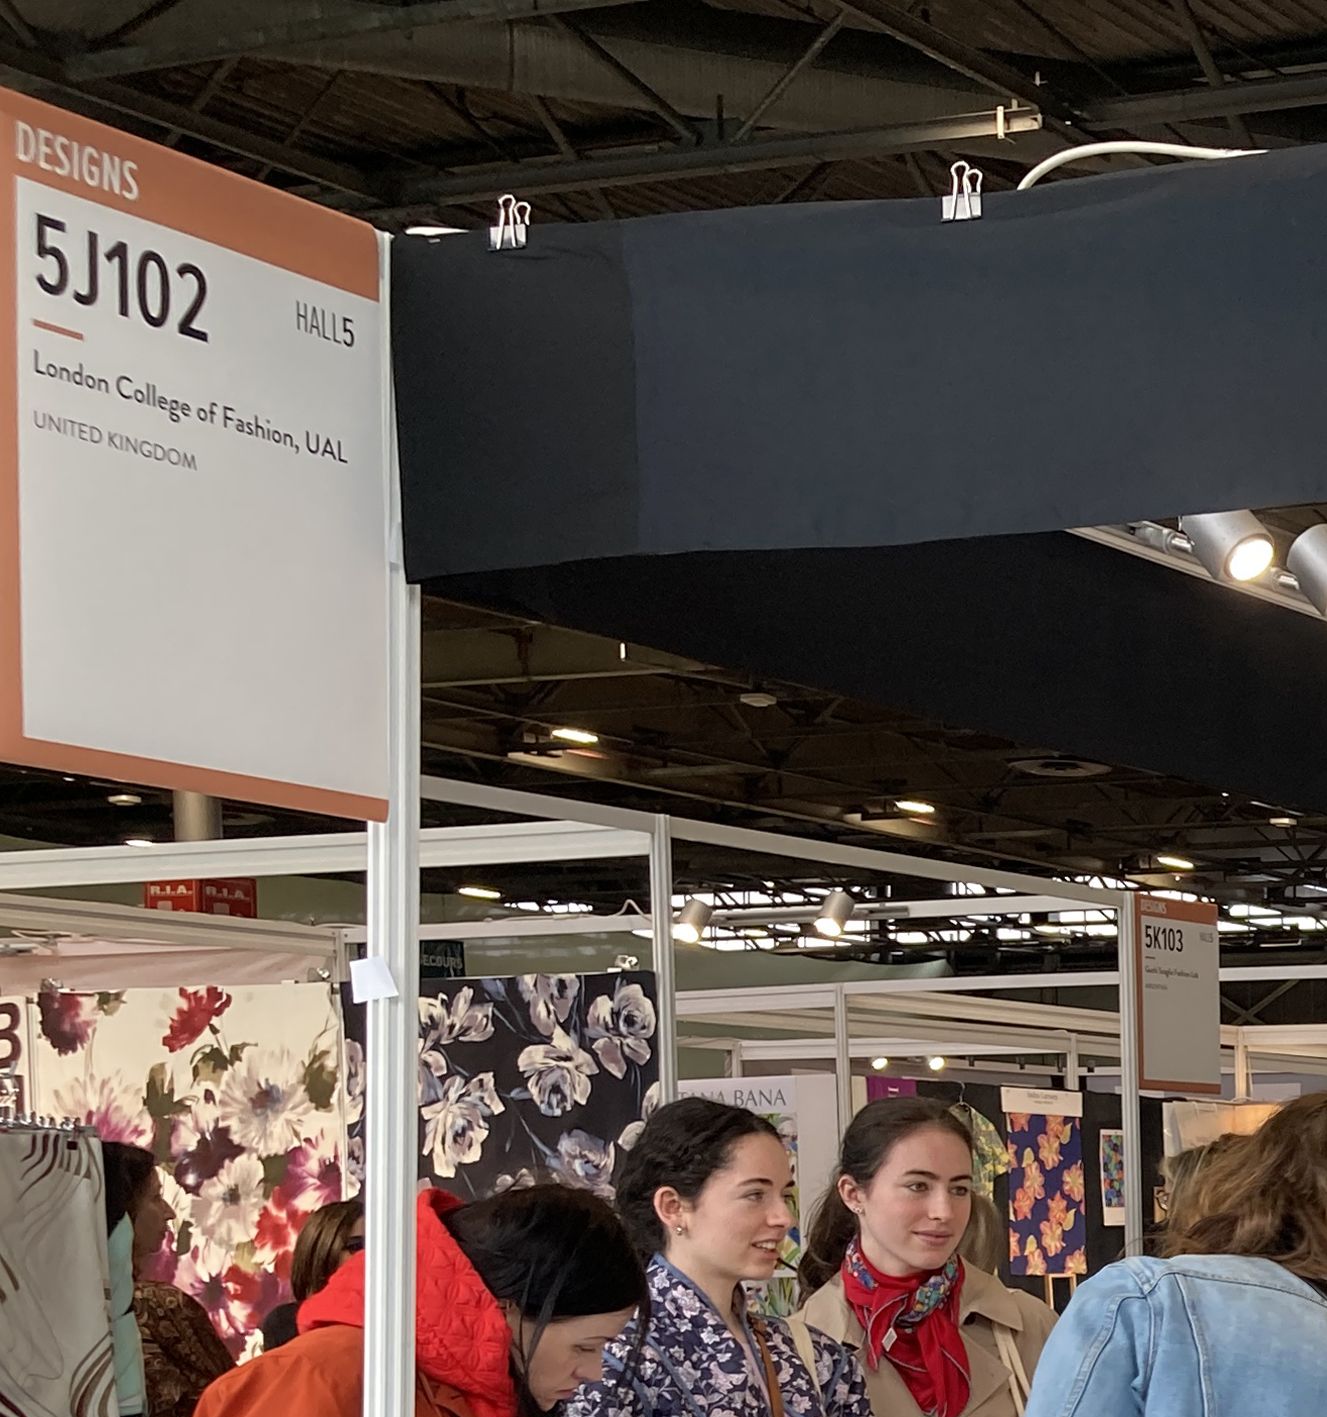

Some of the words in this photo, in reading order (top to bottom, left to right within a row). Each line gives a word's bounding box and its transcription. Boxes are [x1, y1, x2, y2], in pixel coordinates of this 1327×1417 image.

[15, 120, 140, 200] DESIGNS
[35, 212, 209, 343] 5J102
[34, 349, 109, 394] London
[116, 375, 191, 423] College
[197, 401, 217, 423] of
[223, 405, 300, 454] Fashion,
[305, 430, 348, 464] UAL
[33, 410, 103, 444] UNITED
[107, 431, 198, 471] KINGDOM
[420, 954, 463, 970] ECOURS
[1145, 925, 1183, 952] 5K103
[733, 1089, 787, 1107] BANA
